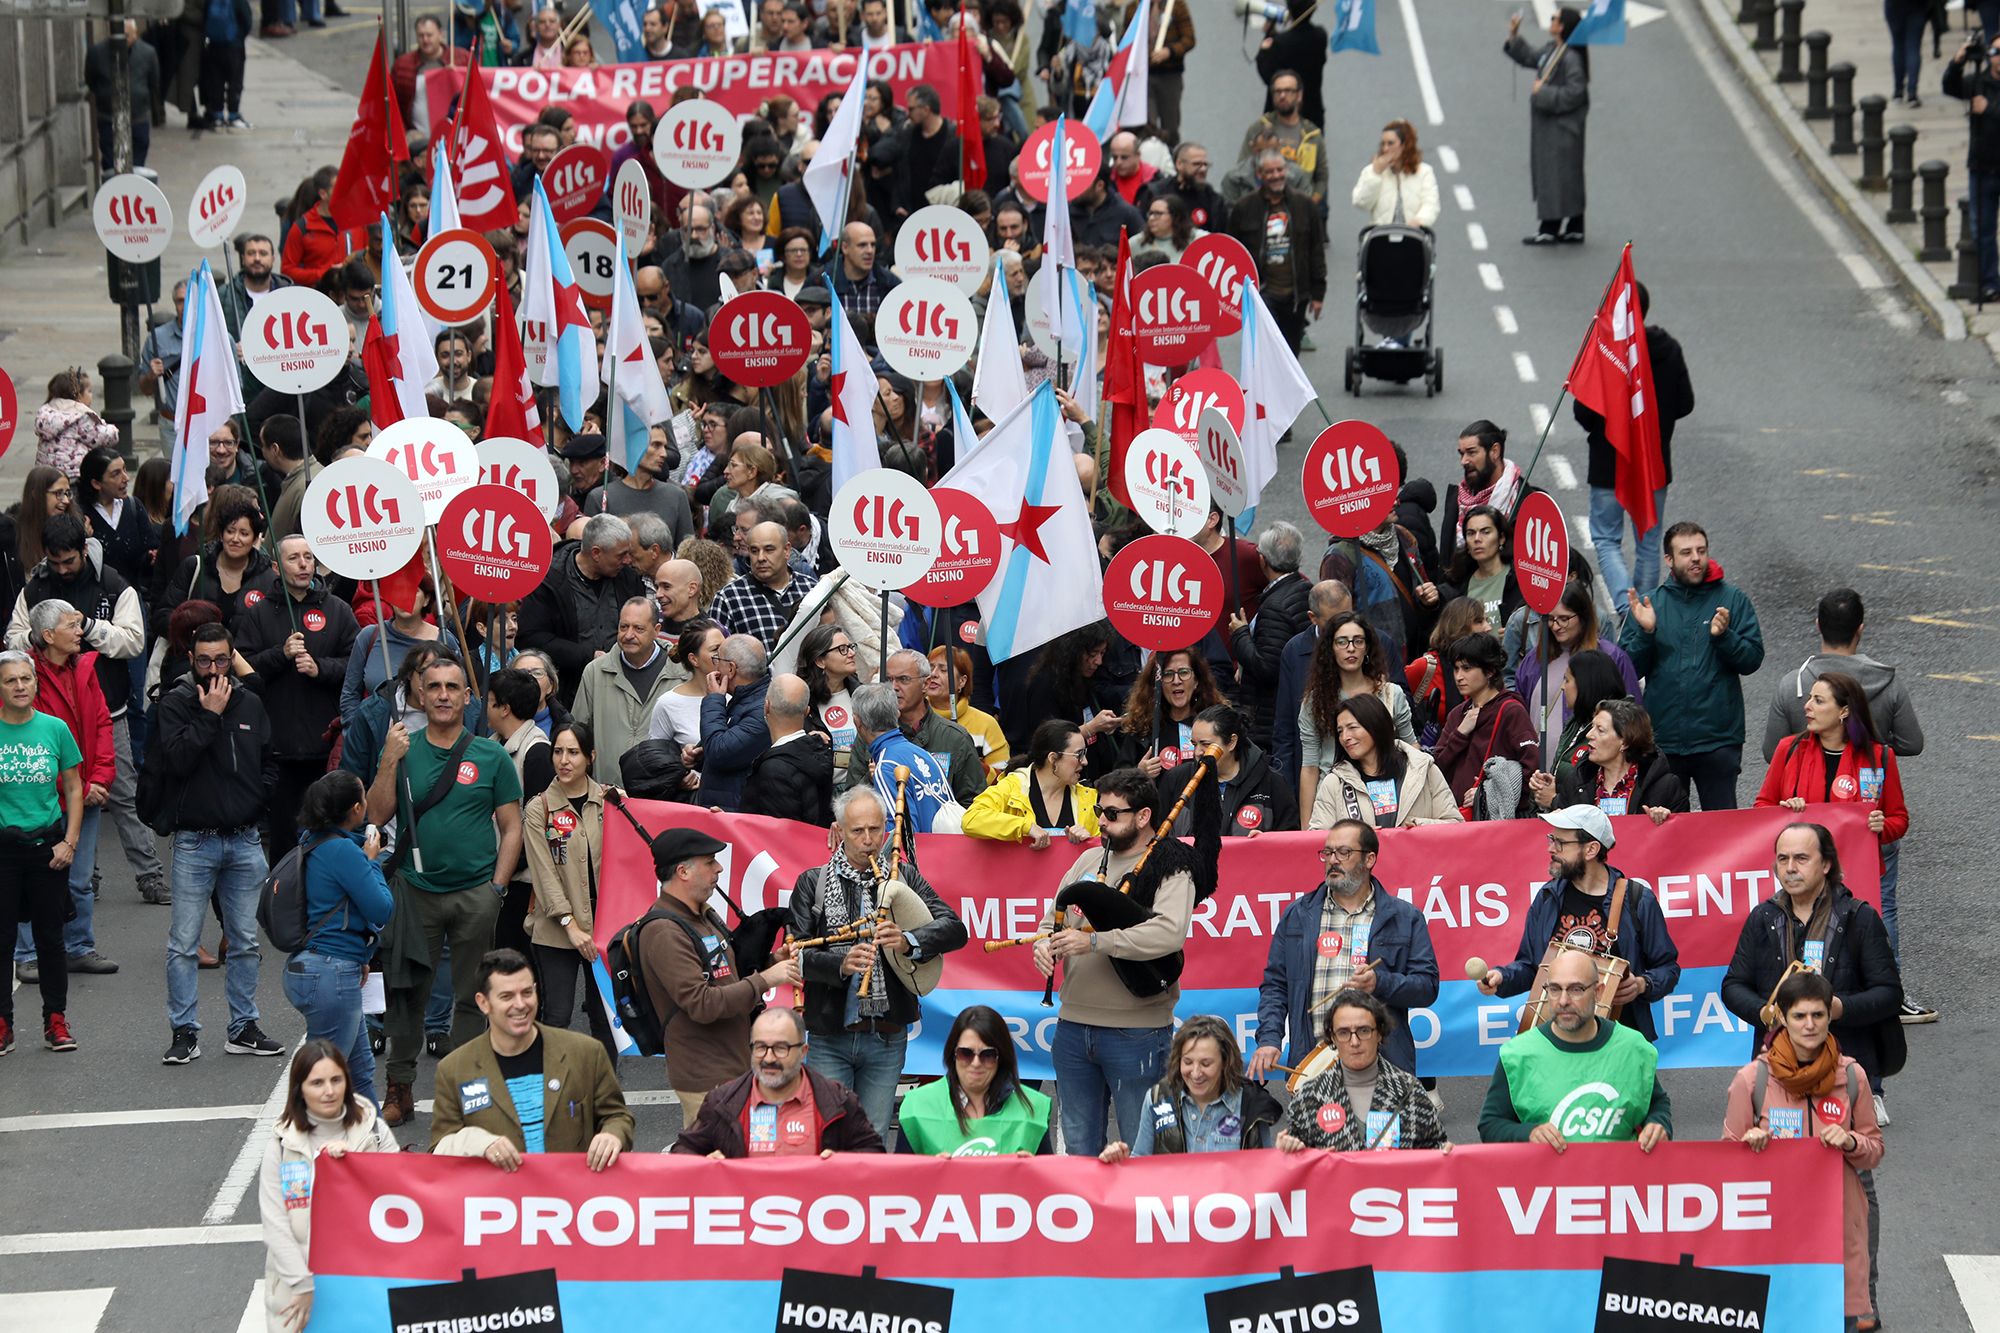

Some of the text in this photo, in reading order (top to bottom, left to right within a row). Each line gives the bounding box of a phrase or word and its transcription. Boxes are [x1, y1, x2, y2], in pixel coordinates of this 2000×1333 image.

[490, 48, 927, 101] POLA RECUPERACIÓN
[672, 119, 724, 152] CIG
[1036, 136, 1086, 170] CG
[553, 160, 595, 197] CIG
[109, 195, 158, 226] CIG
[200, 183, 234, 221] CIG
[621, 181, 643, 220] CIG
[914, 227, 971, 263] CIG
[437, 264, 473, 290] 21
[577, 251, 614, 279] 18
[1197, 251, 1244, 306] CIG
[898, 299, 959, 340] CIG
[1139, 287, 1201, 325] CIG
[262, 311, 329, 351] CIG
[729, 312, 793, 348] CIG
[1153, 334, 1186, 346] ENSINO
[281, 359, 315, 373] ENSINO
[744, 356, 778, 368] ENSINO
[908, 347, 942, 360] ENSINO
[1207, 426, 1238, 481] CIG
[1321, 444, 1382, 493] CIG
[1145, 449, 1195, 501] CIG
[325, 483, 401, 530] CIG
[420, 489, 443, 502] SINO
[1340, 497, 1371, 516] ENSINO
[462, 507, 531, 559] CIG
[853, 495, 920, 542] CIG
[315, 525, 416, 545] Confederación Intersindical Galega
[348, 540, 388, 555] ENSINO
[838, 537, 931, 554] Confederación Intersindical Galega
[1525, 516, 1559, 568] CIG
[446, 548, 541, 571] Confederación Intersindical Galega
[473, 563, 511, 580] ENSINO
[867, 551, 903, 565] ENSINO
[971, 556, 992, 566] Galega
[926, 569, 964, 584] ENSINO
[1130, 559, 1202, 606] CIG
[1113, 601, 1212, 618] Confederación Intersindical Galega
[1142, 614, 1181, 628] ENSINO
[464, 1096, 489, 1111] STEG
[1822, 1101, 1841, 1115] CIG
[786, 1120, 805, 1133] CIG
[1155, 1114, 1176, 1130] STEG
[1562, 1106, 1627, 1137] CSIF
[369, 1181, 1772, 1247] O PROFESORADO NON SE VENDE
[781, 1301, 945, 1333] HORARIOS
[1604, 1292, 1761, 1330] BUROCRACIA
